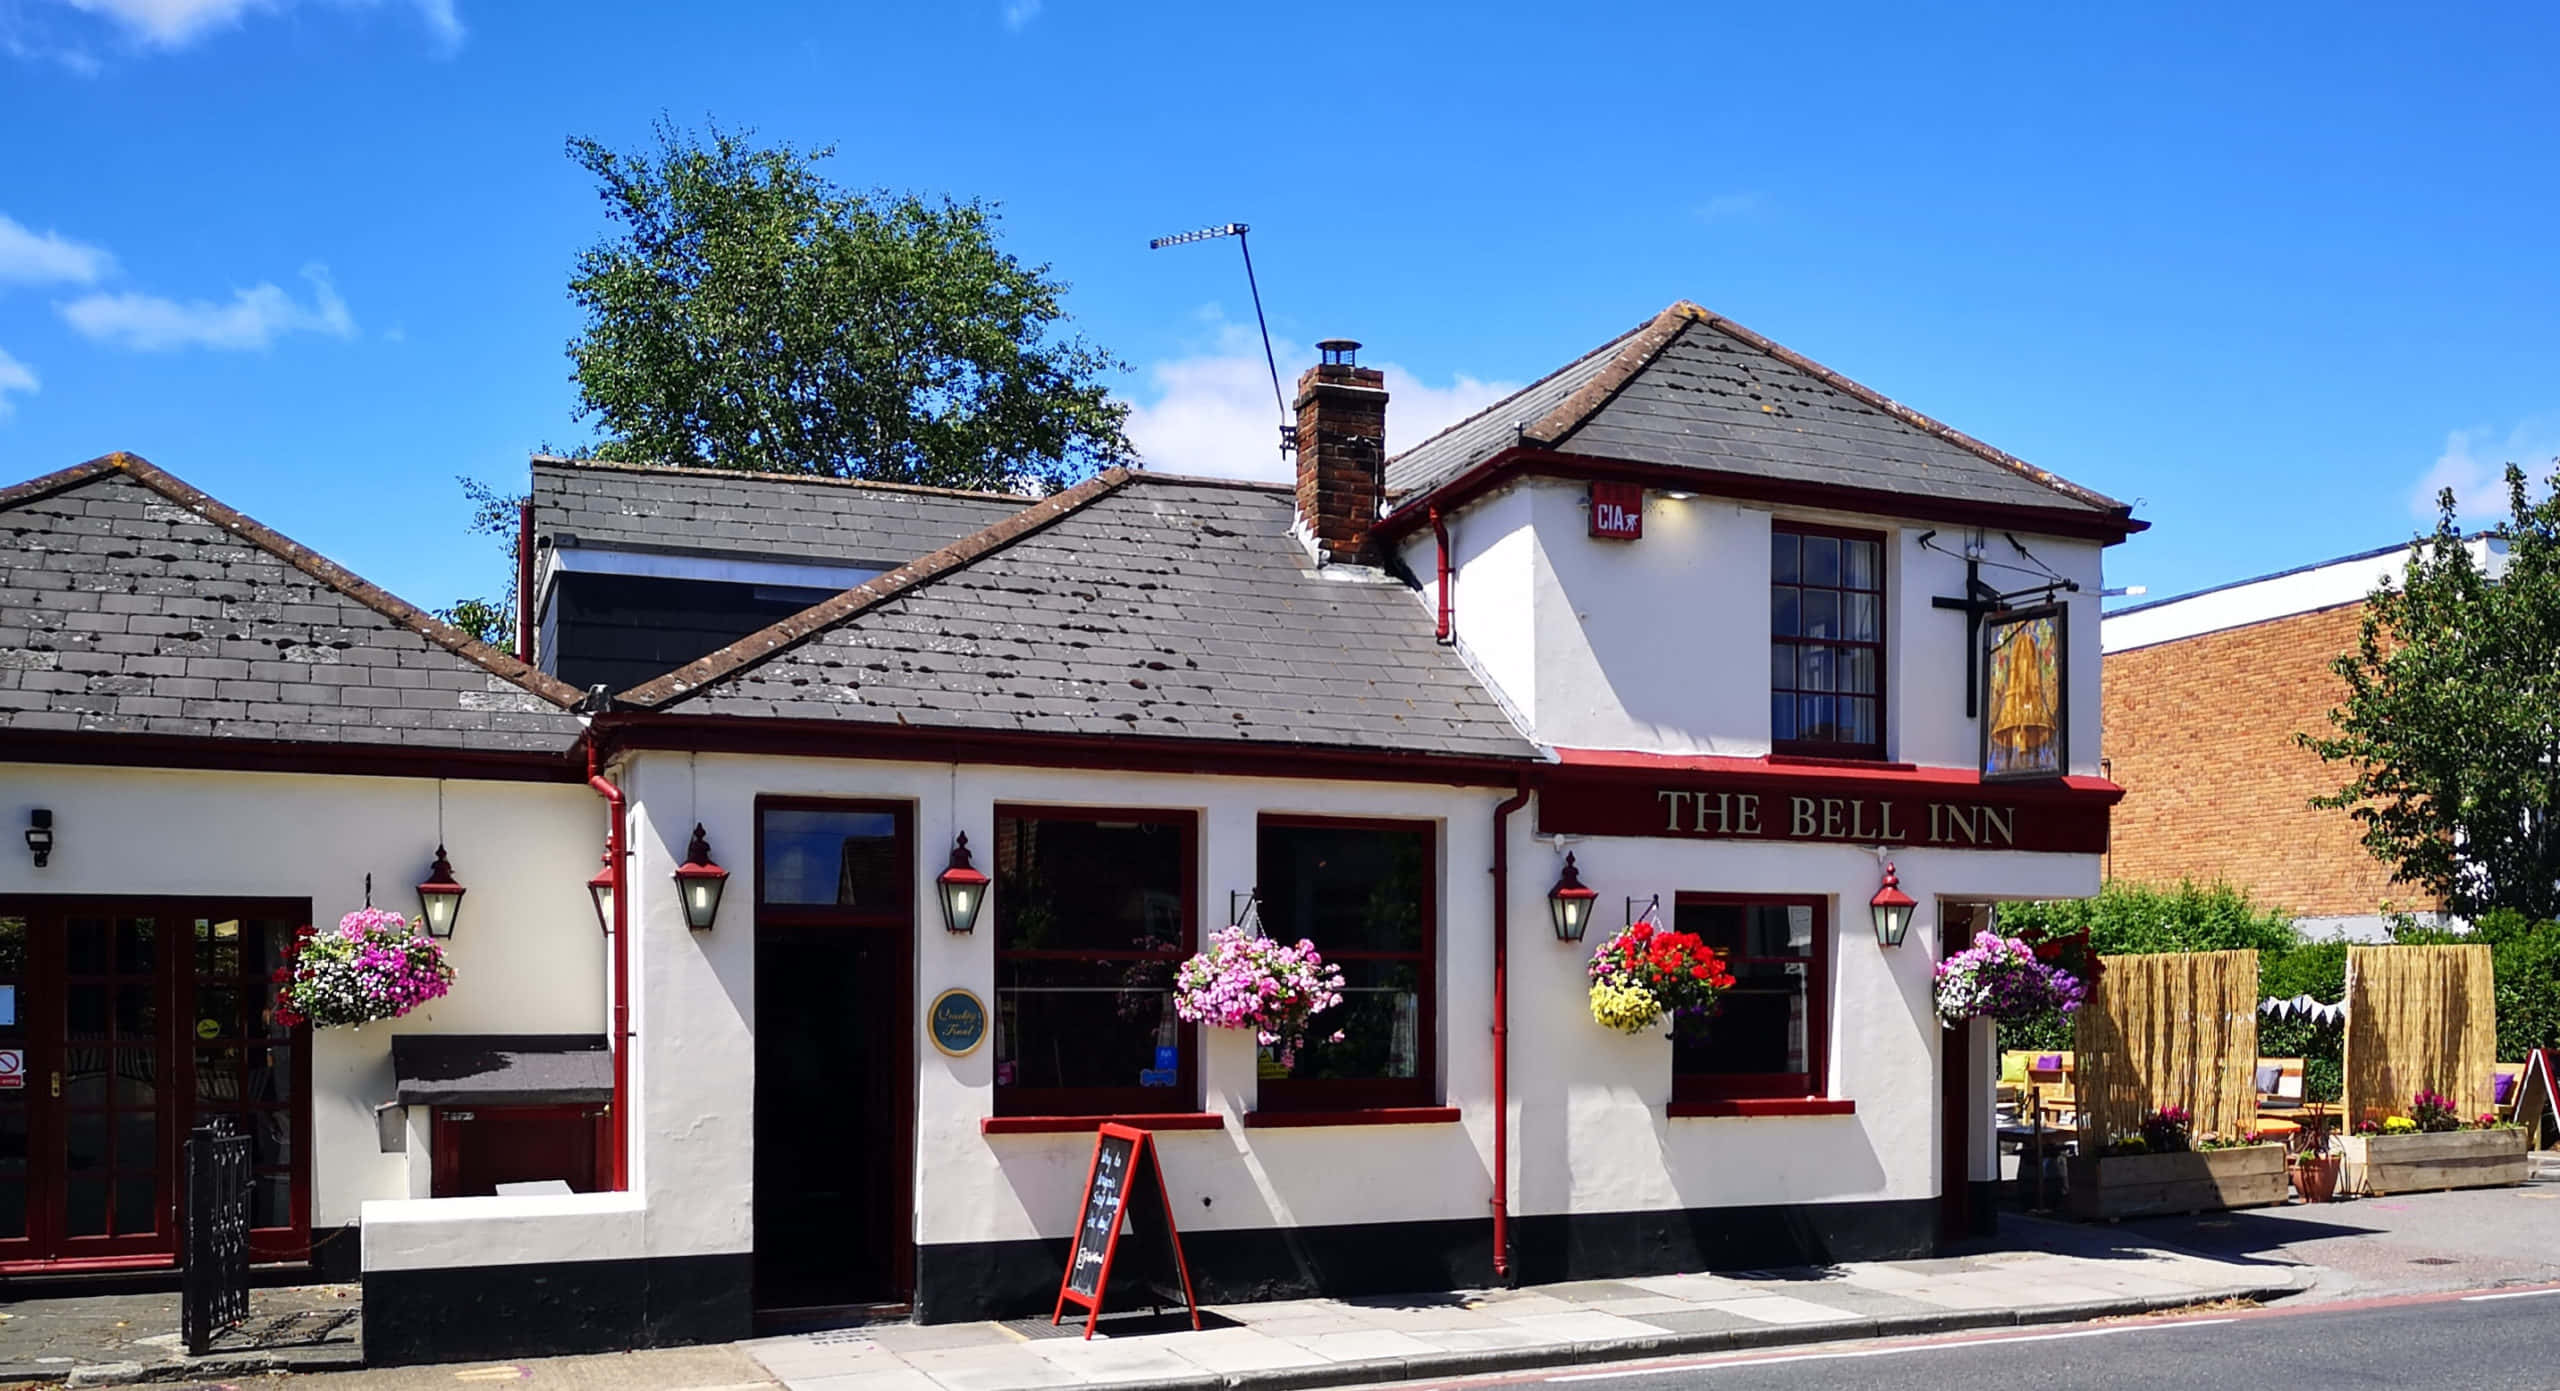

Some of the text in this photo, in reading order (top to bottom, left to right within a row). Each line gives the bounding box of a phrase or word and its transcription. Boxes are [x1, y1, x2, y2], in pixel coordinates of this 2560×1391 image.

[1598, 504, 1624, 531] CIA
[1657, 789, 2015, 845] THE BELL INN
